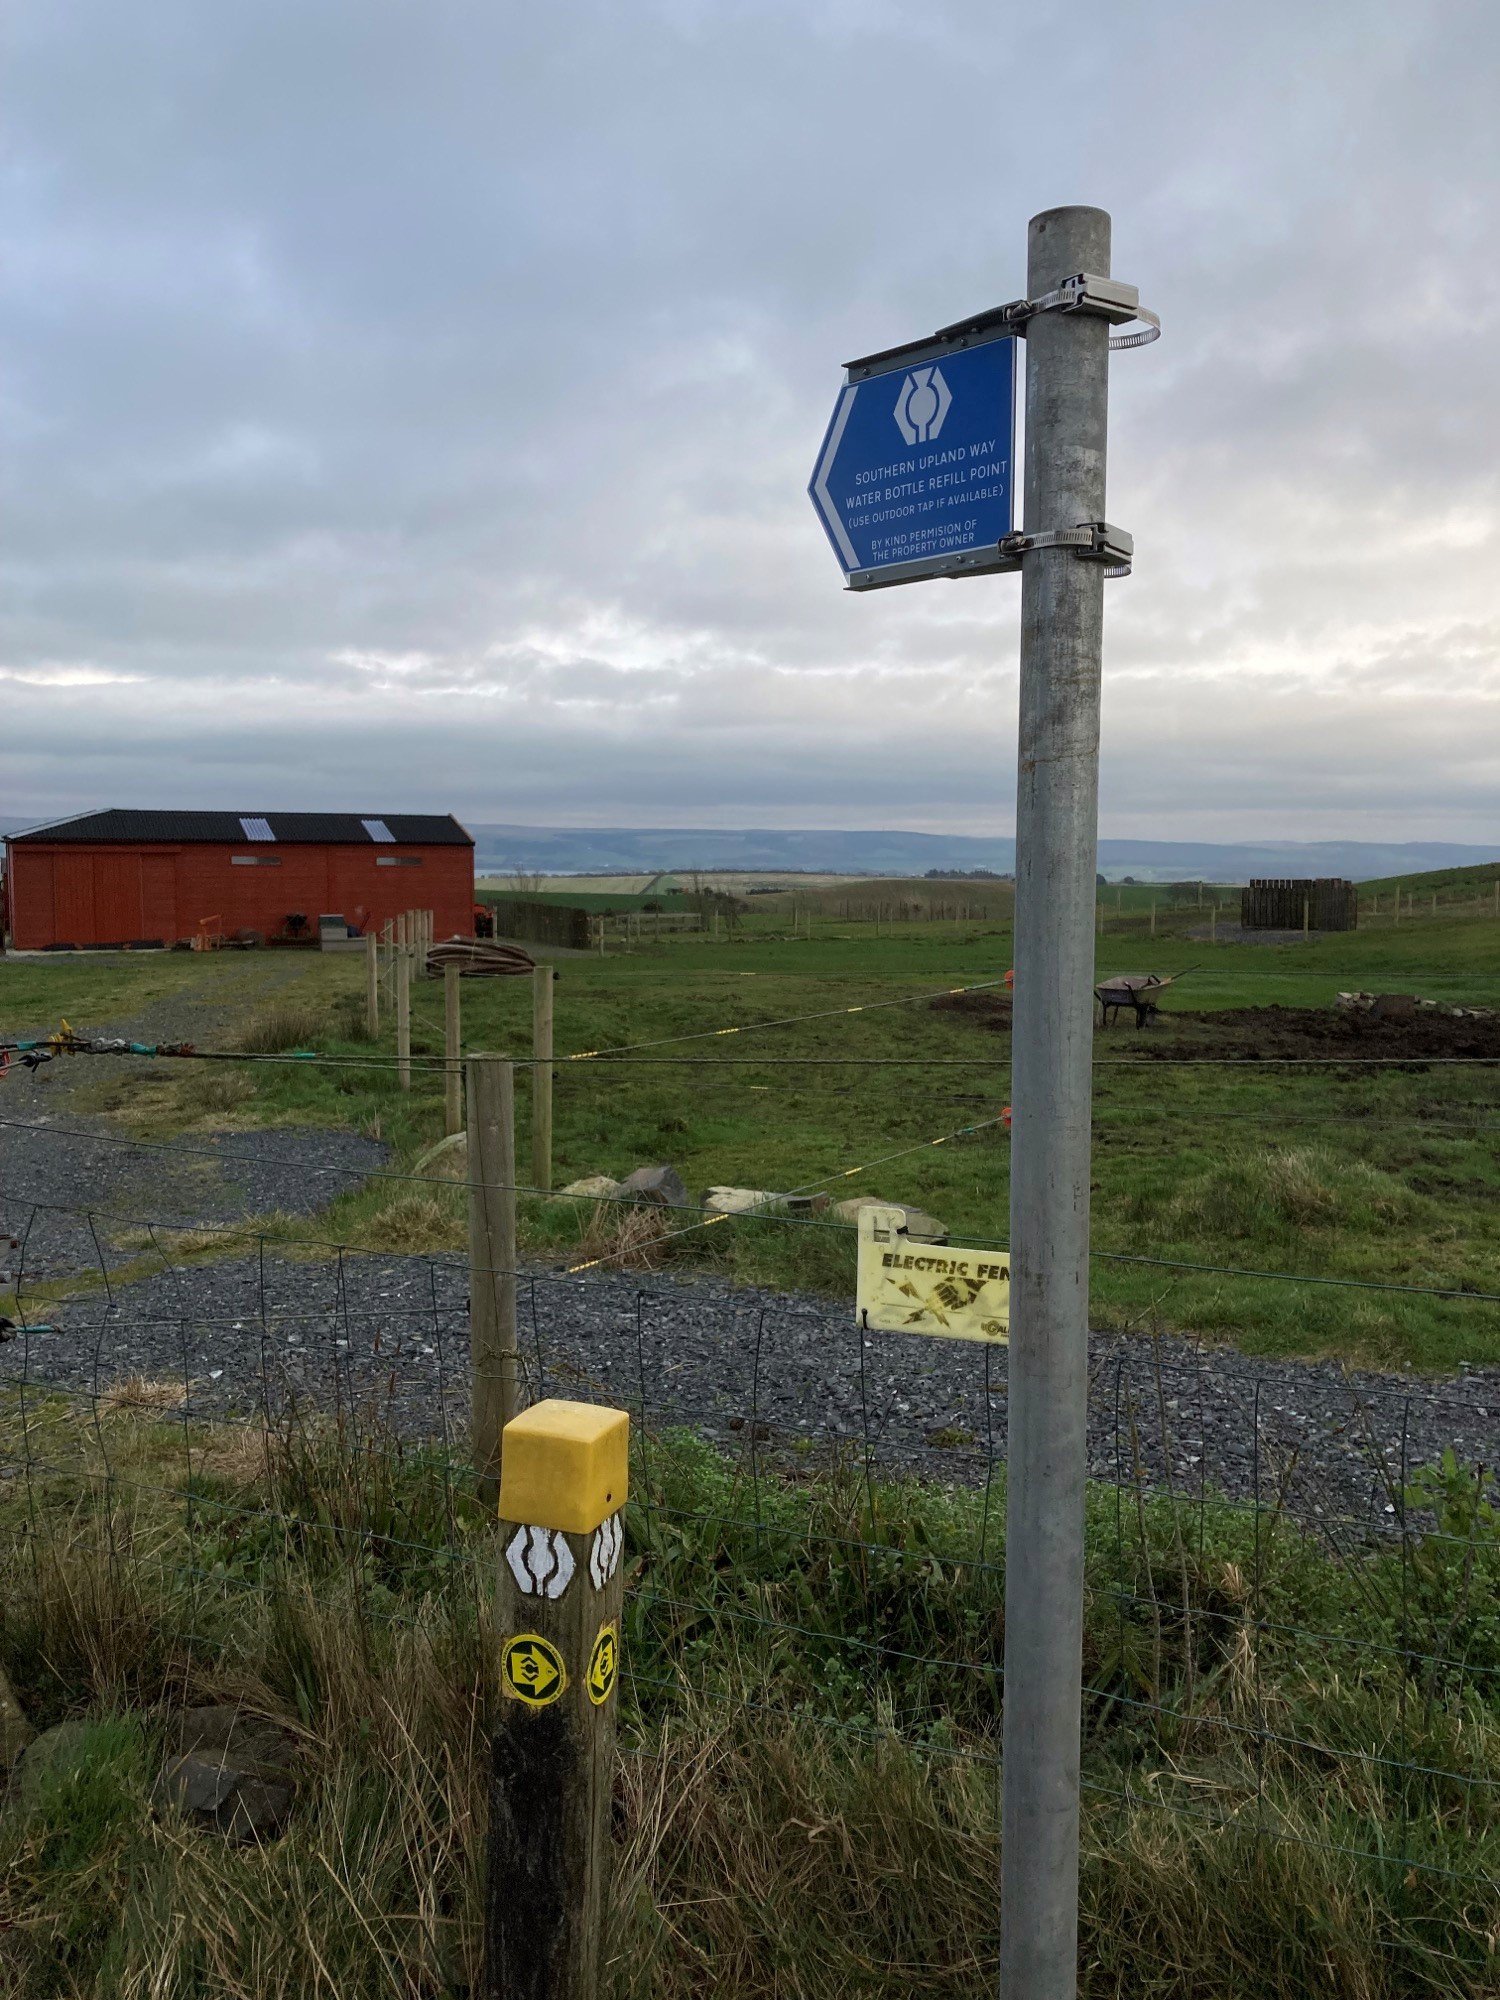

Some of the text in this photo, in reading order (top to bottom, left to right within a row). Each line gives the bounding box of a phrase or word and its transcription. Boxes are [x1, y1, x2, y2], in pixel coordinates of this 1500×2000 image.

[855, 439, 996, 485] SOUTHERN UPLAND WAY
[846, 460, 1007, 510] WATER BOTTLE REFILL POINT
[848, 484, 1004, 529] (USE OUTDOOR TAP IF AVAILABLE)
[871, 519, 978, 550] BY KIND PERMISION OF
[872, 532, 975, 562] THE PROPERTY OWNER
[882, 1253, 968, 1276] ELECTRIC
